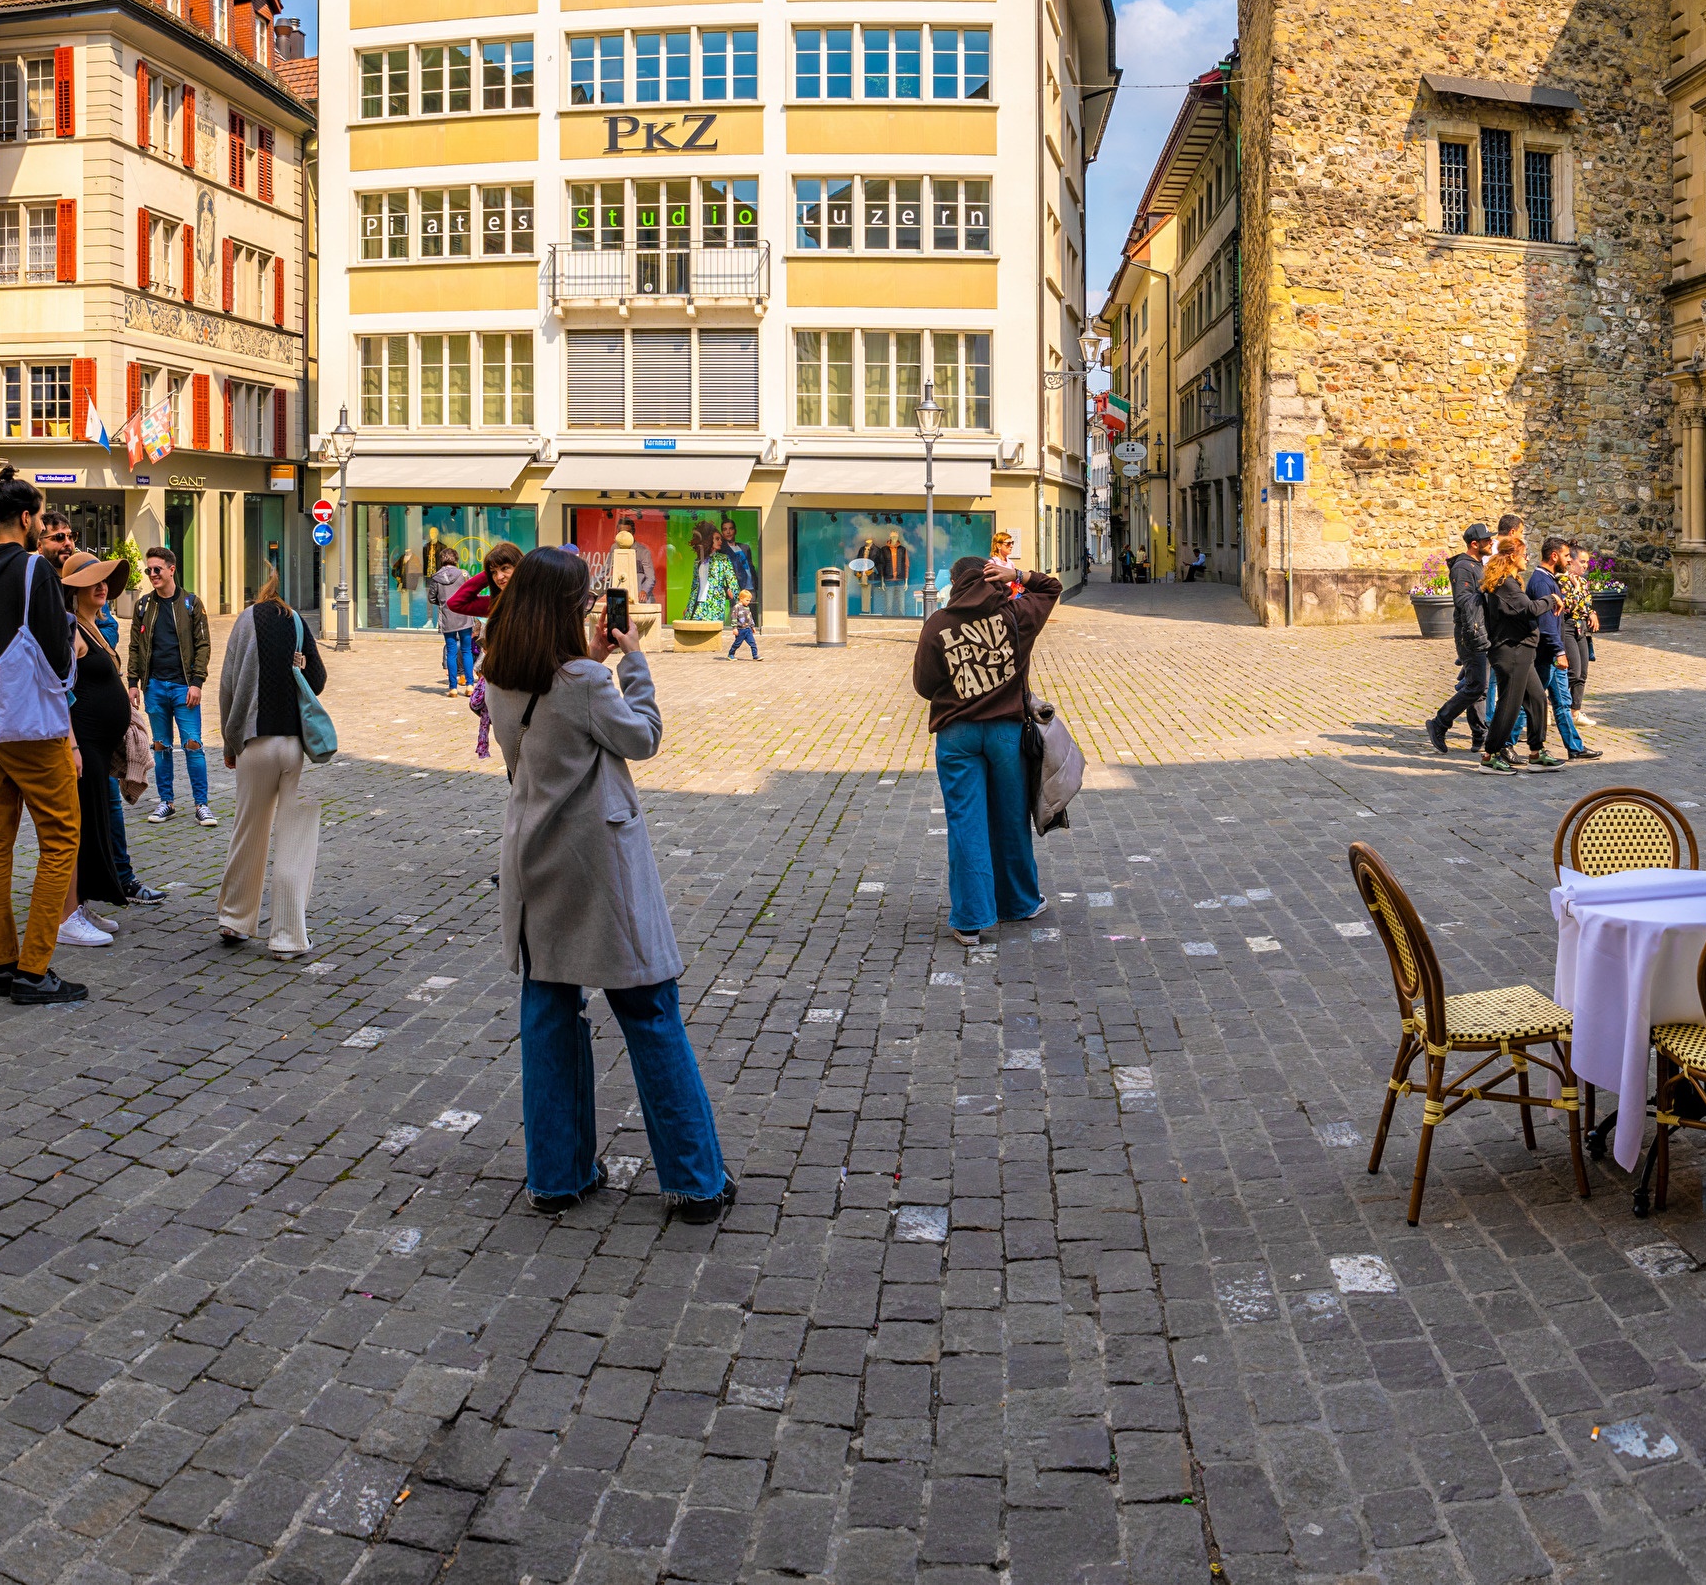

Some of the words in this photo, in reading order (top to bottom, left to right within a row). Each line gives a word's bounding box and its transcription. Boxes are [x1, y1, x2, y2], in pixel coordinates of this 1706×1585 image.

[366, 213, 532, 237] Pilates
[576, 204, 754, 229] Studio
[801, 207, 985, 227] Luzern
[168, 475, 206, 488] GANT
[938, 614, 1008, 649] LOVE
[944, 639, 1014, 676] NEVER
[953, 658, 1016, 700] FAILS
